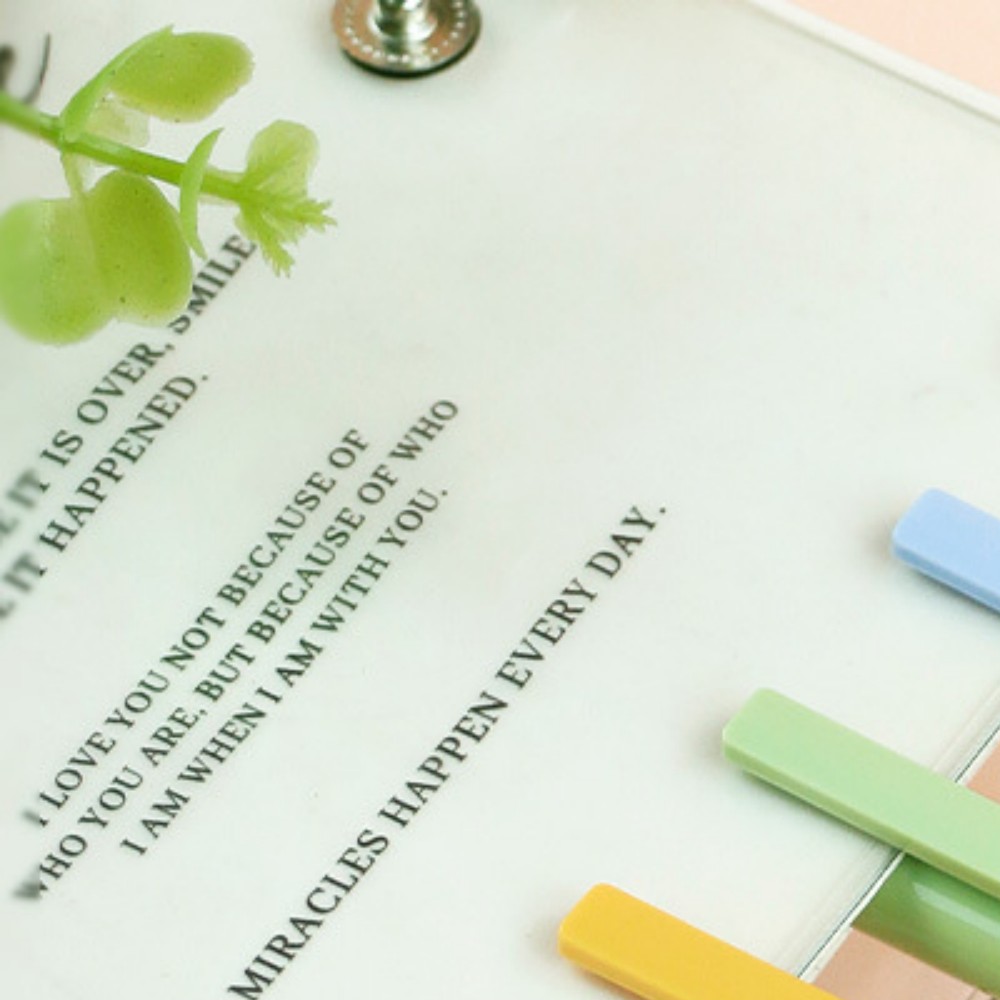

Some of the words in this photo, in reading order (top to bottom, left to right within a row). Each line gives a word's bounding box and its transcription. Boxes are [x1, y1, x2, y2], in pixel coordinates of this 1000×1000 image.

[37, 375, 208, 553] HAPPENED.
[39, 429, 84, 468] IS
[76, 342, 175, 426] OVER,
[167, 234, 258, 336] SMILE
[38, 731, 117, 810] LOVE
[104, 669, 169, 729] YOU
[160, 606, 226, 672] NOT
[216, 471, 337, 607] BECAUSE
[327, 428, 369, 470] OF
[77, 765, 144, 829] YOU
[140, 707, 207, 767] ARE,
[193, 643, 256, 703] BUT
[245, 506, 366, 645] BECAUSE
[356, 463, 398, 506] OF
[388, 400, 459, 461] WHO
[120, 838, 148, 856] I
[140, 787, 191, 839] AM
[177, 702, 267, 783] WHEN
[255, 686, 283, 704] I
[275, 637, 324, 688] AM
[309, 551, 390, 633] WITH
[376, 488, 448, 549] YOU.
[377, 690, 509, 828] HAPPEN
[494, 578, 598, 690] EVERY
[584, 506, 666, 579] DAY.
